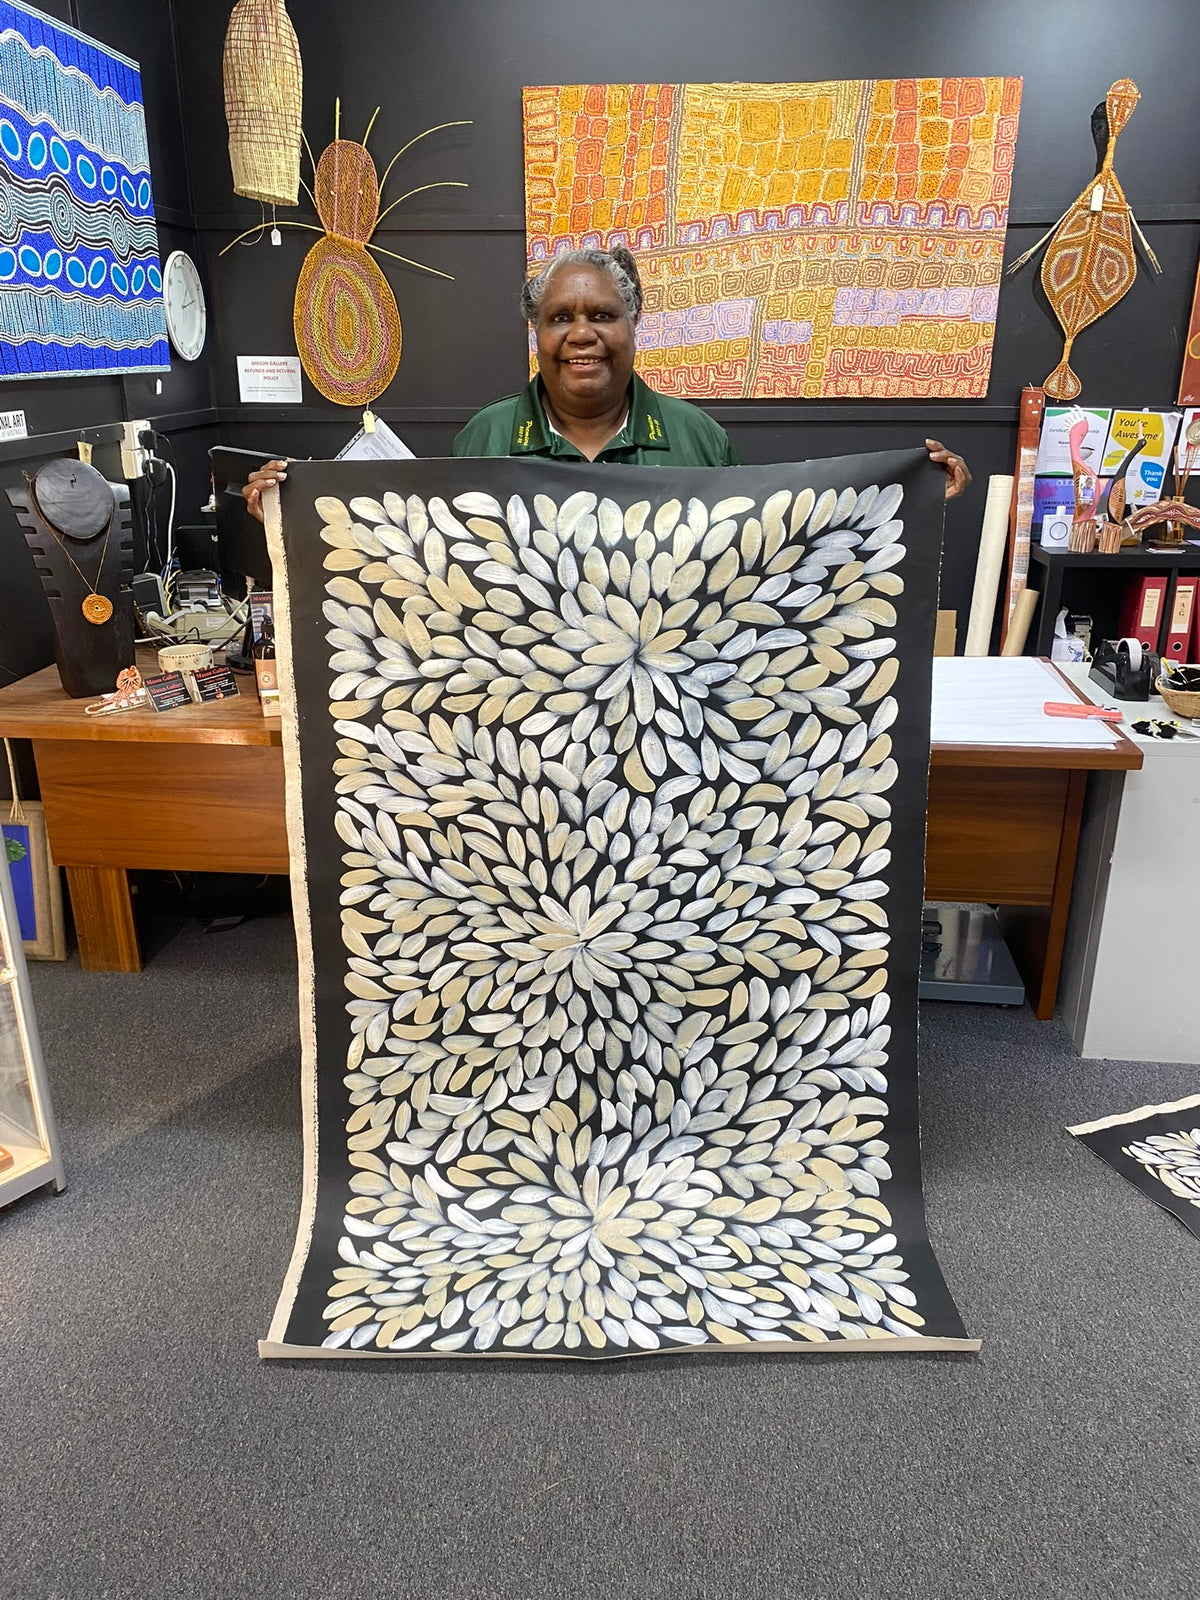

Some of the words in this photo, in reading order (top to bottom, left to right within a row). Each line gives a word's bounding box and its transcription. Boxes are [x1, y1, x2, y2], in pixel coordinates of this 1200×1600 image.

[12, 413, 24, 428] ART
[1115, 430, 1163, 440] Awesme!
[195, 671, 212, 679] Mason
[211, 666, 229, 674] Gallery
[150, 686, 166, 694] Mason
